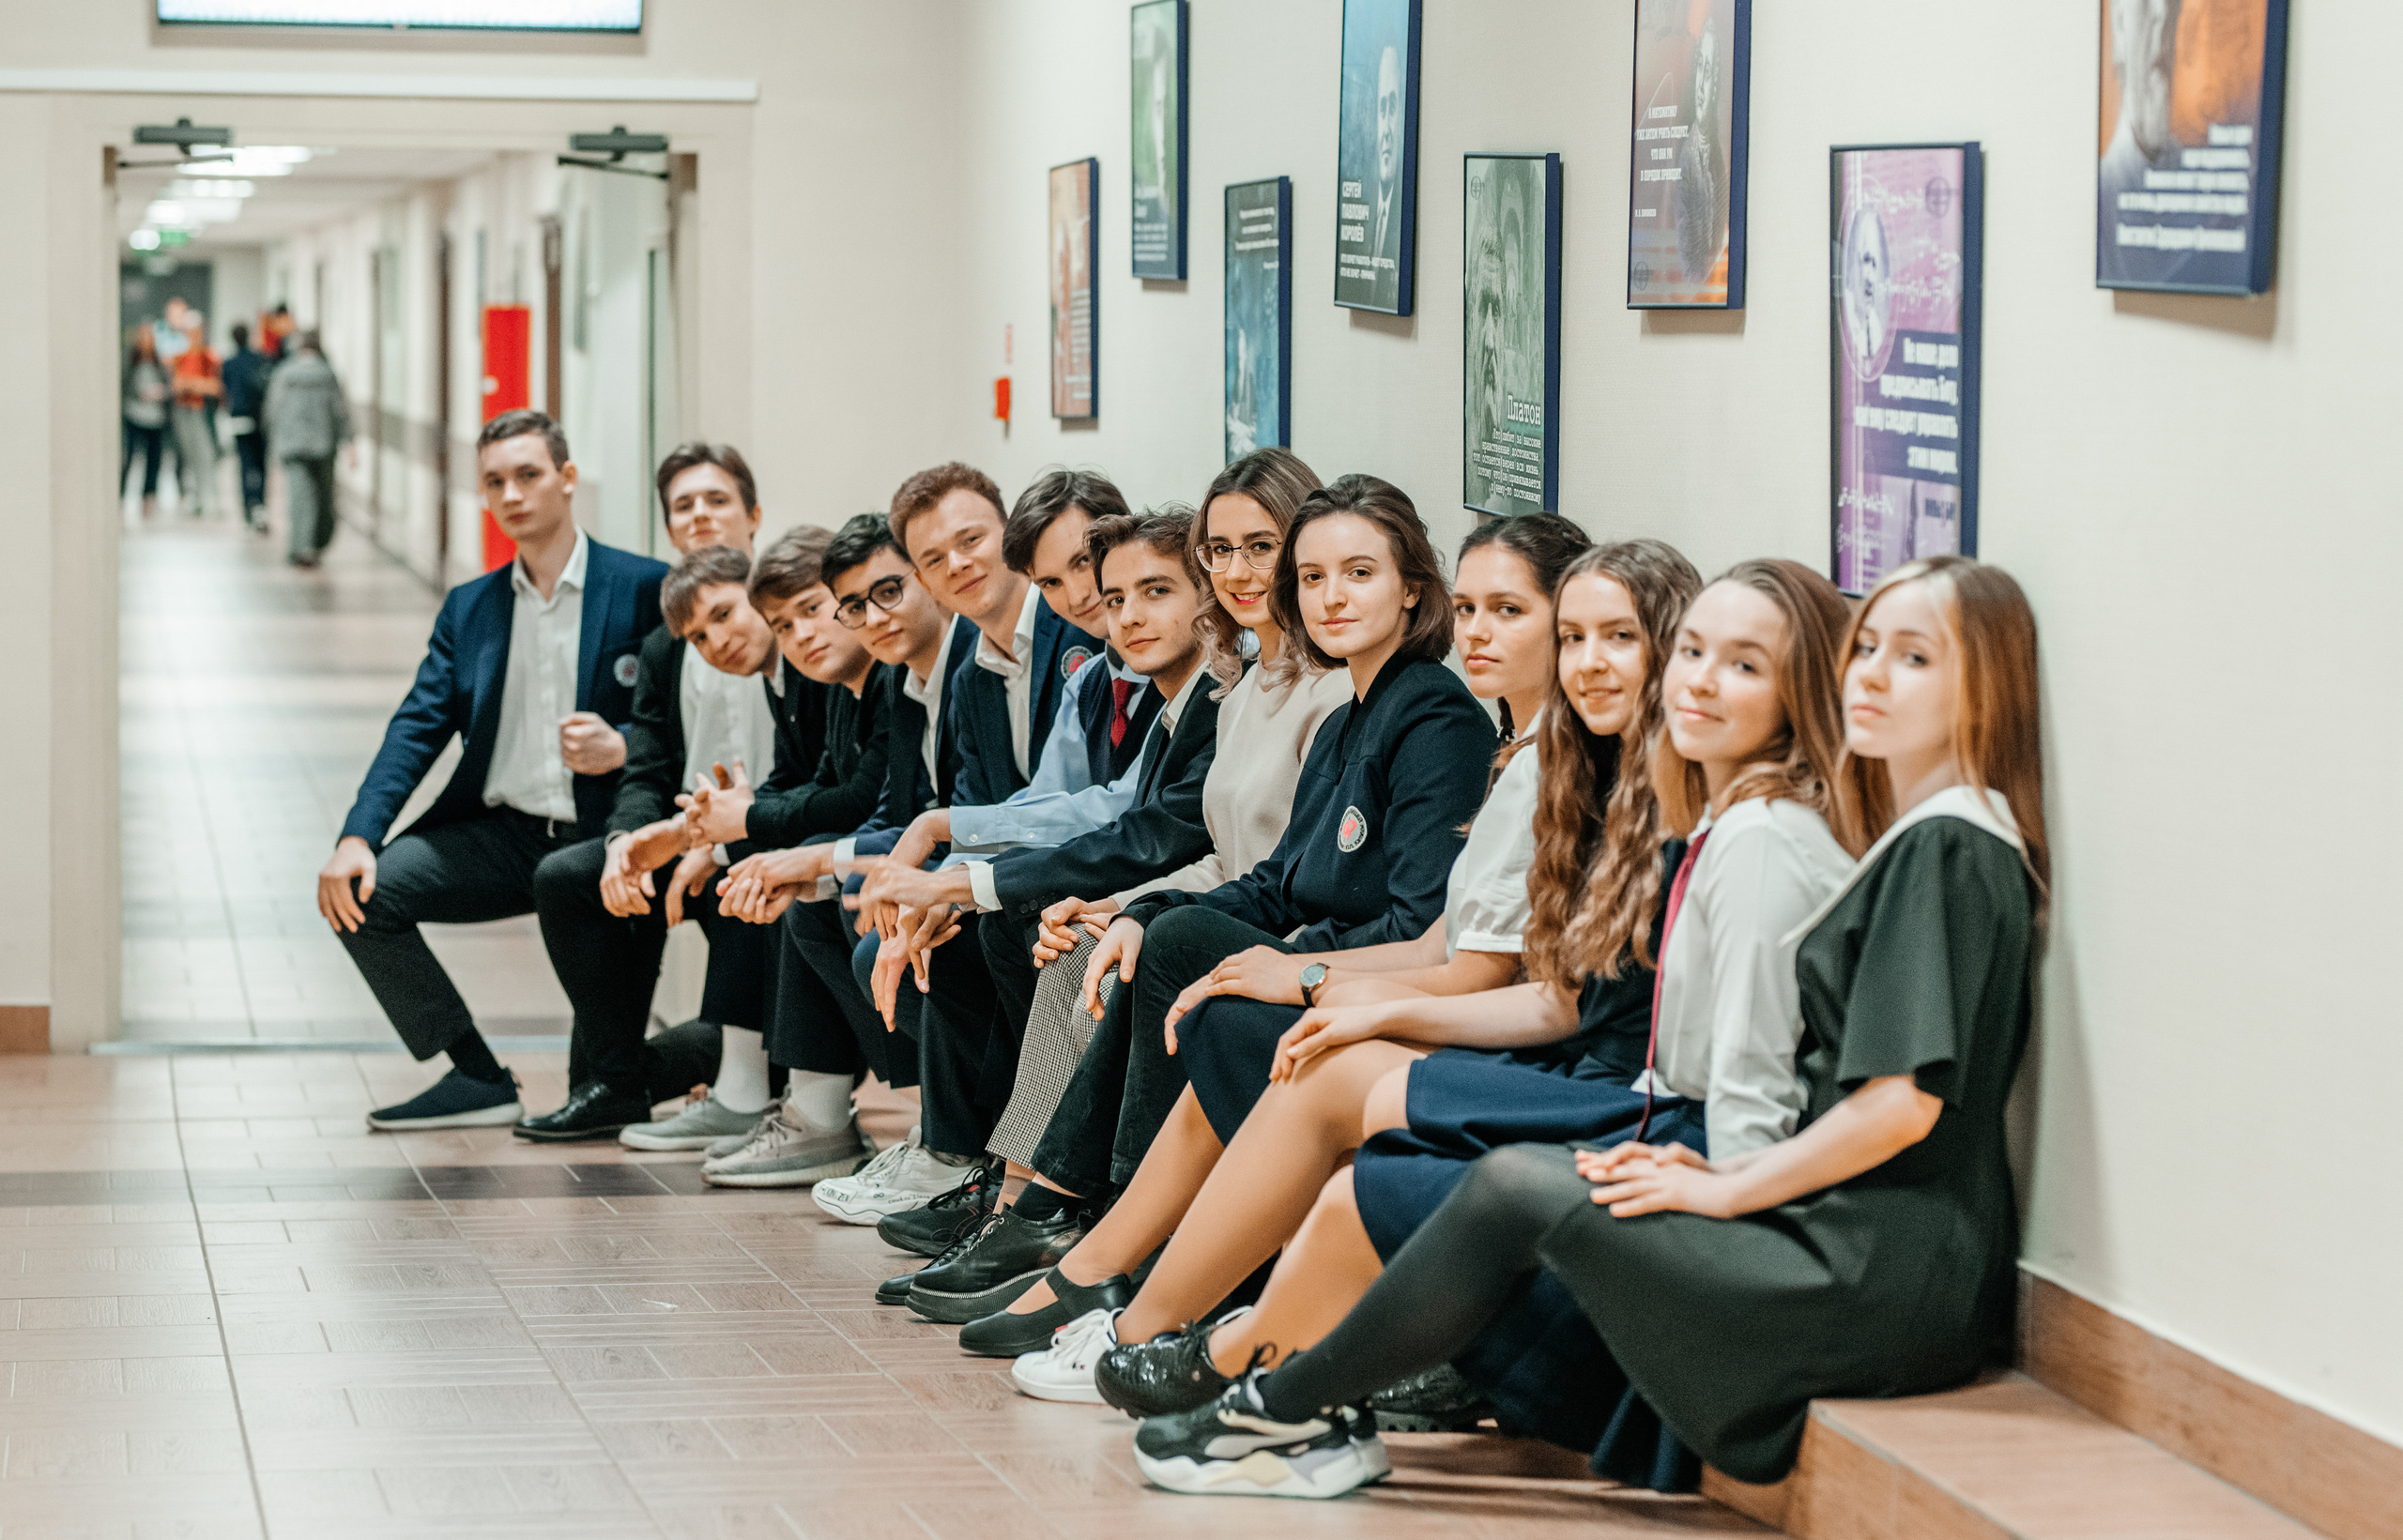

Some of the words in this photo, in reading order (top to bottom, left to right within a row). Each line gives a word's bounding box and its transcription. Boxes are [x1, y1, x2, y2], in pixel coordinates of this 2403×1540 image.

[1342, 179, 1361, 198] СЕРГЕЙ
[1341, 203, 1369, 221] ПАВЛОВИЧ
[1508, 394, 1540, 425] Платон
[1482, 441, 1509, 454] нравственные
[1516, 435, 1522, 444] за
[1523, 436, 1540, 449] высокие
[1502, 459, 1514, 472] верен
[1477, 466, 1492, 480] потому
[1509, 474, 1540, 489] привязывается
